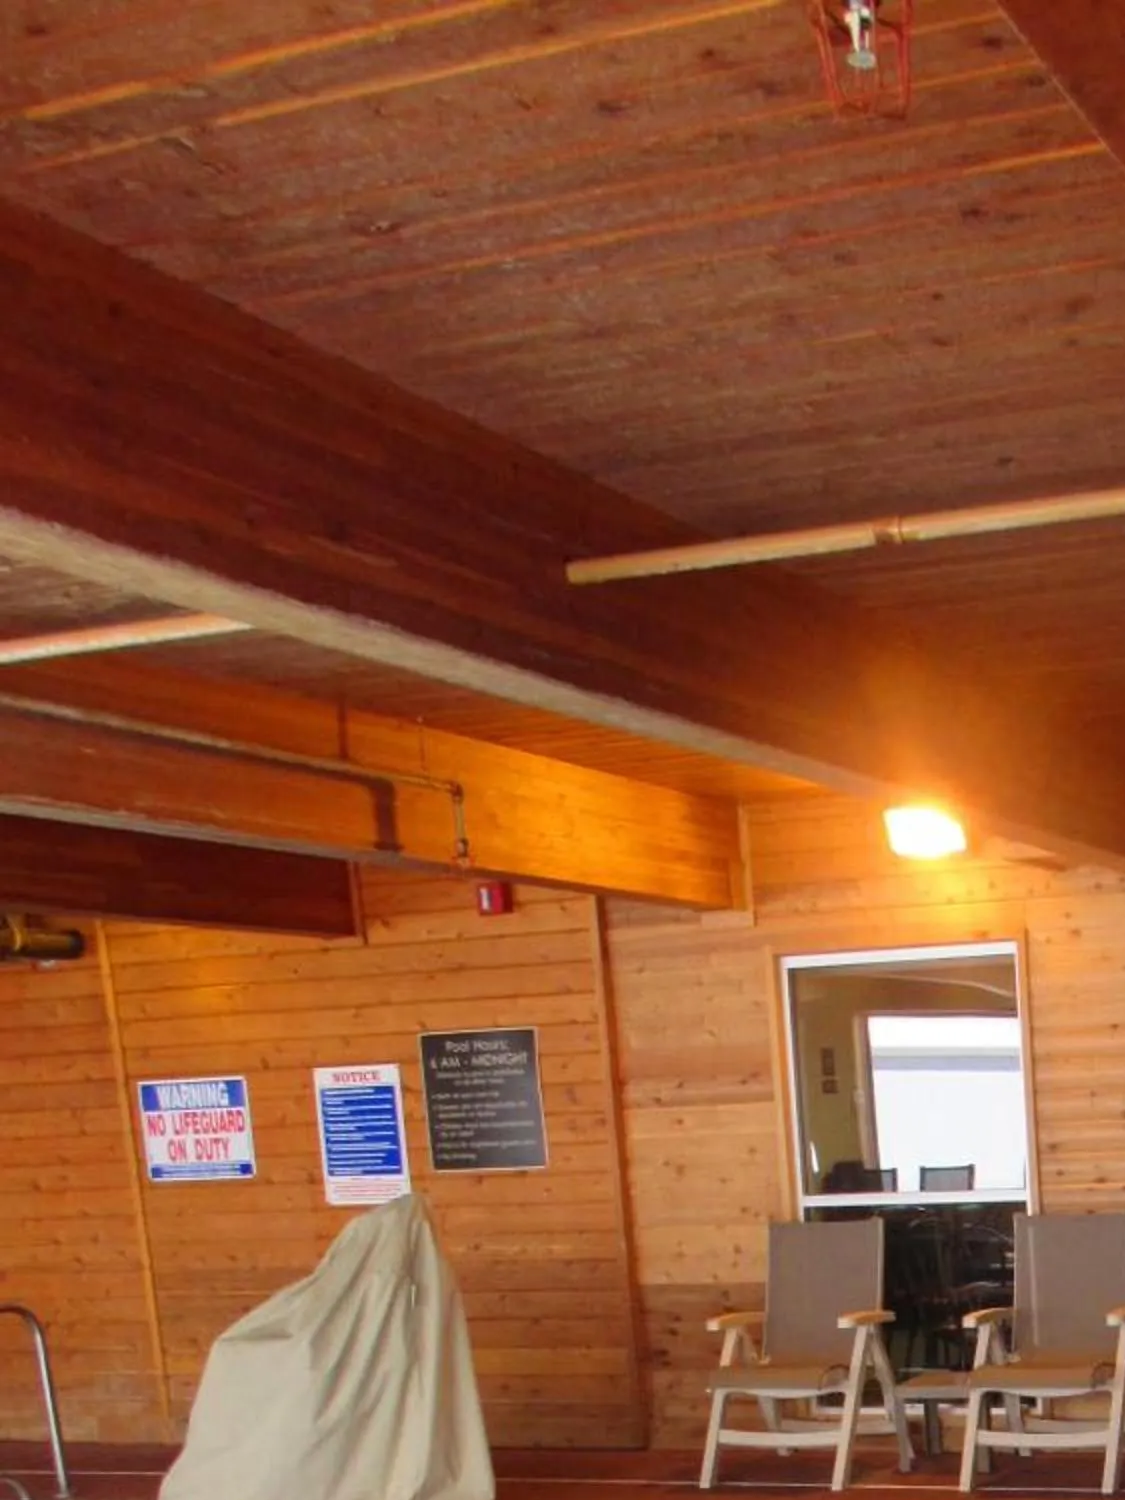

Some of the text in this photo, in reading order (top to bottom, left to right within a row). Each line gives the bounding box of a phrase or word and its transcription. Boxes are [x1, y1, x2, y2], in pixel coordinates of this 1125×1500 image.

[471, 1051, 528, 1067] MIDNIGHT
[332, 1071, 381, 1083] NOTICE
[157, 1082, 229, 1111] WARNING
[147, 1110, 245, 1137] NO LIFEGUARD
[167, 1137, 230, 1162] ON DUTY
